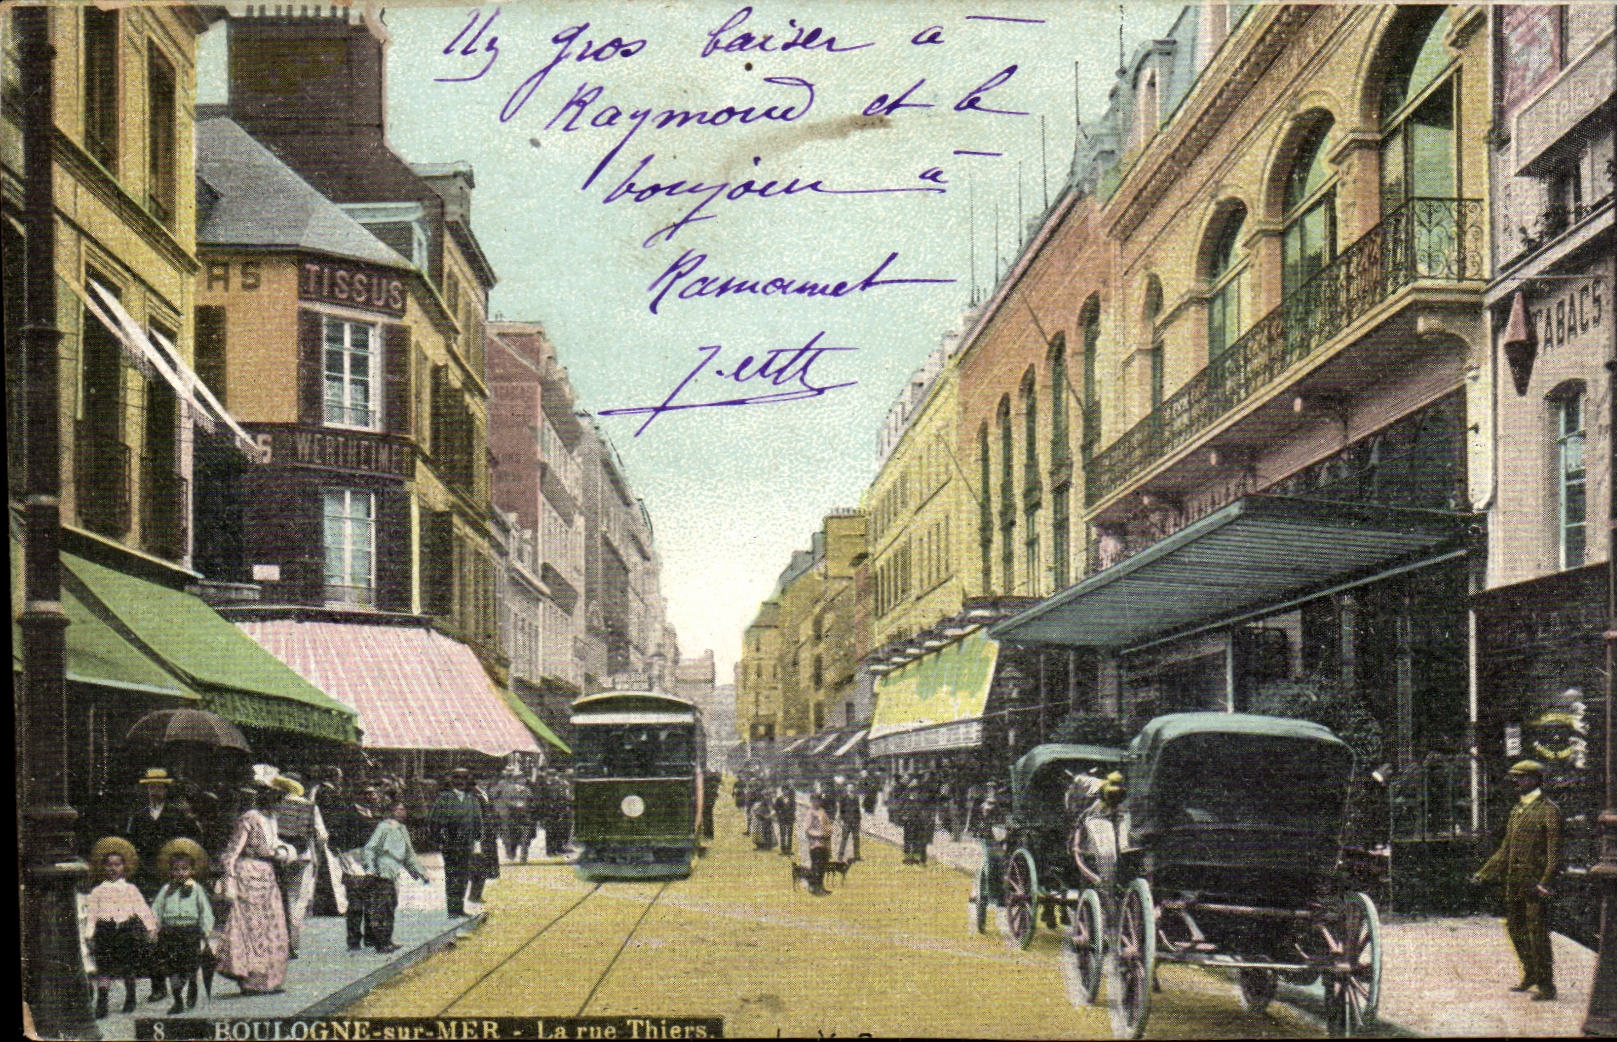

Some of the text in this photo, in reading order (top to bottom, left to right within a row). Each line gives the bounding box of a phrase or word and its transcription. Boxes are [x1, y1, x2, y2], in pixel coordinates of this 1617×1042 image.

[500, 22, 647, 123] gros
[701, 6, 875, 57] baiser
[544, 77, 815, 190] Raymond
[862, 78, 935, 117] et
[305, 264, 403, 309] TISSUS
